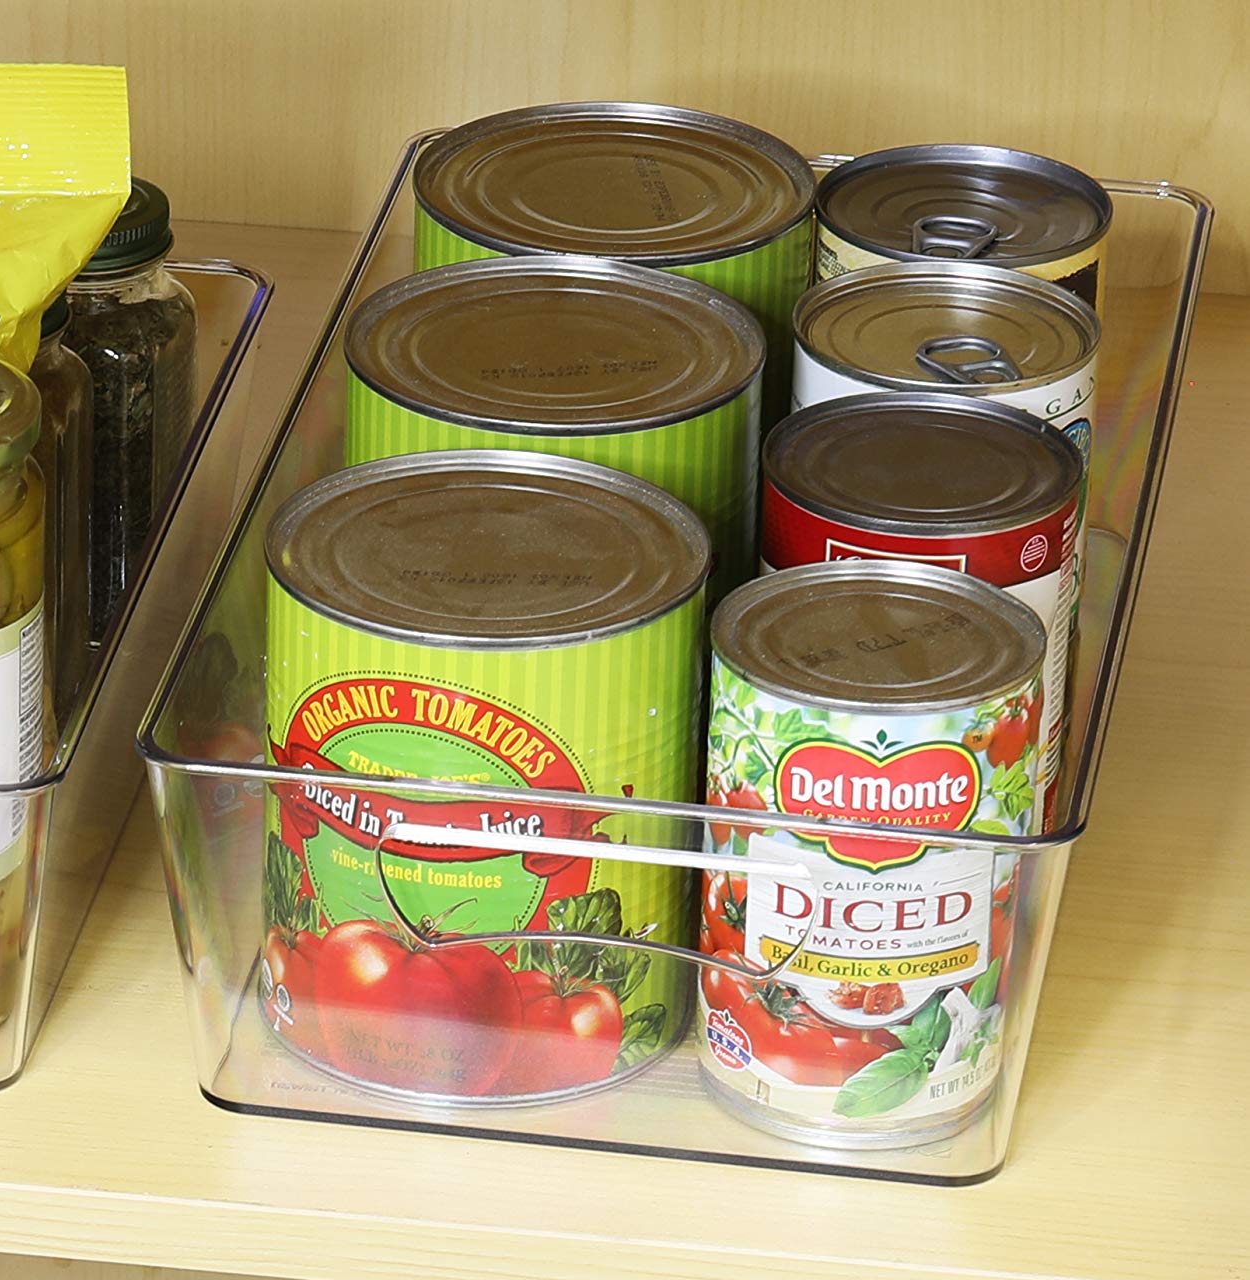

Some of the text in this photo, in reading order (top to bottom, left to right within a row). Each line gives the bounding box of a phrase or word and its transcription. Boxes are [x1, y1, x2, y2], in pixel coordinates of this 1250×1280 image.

[301, 684, 556, 779] ORGANIC TOMATOES
[791, 766, 969, 812] Del Monte
[358, 801, 382, 837] in
[877, 811, 952, 826] QUALITY
[427, 863, 503, 889] tomatoes
[822, 881, 924, 893] CALIFORNIA
[774, 881, 973, 933] DICED
[817, 954, 969, 977] Garlic & Oregano
[929, 1082, 946, 1099] NET
